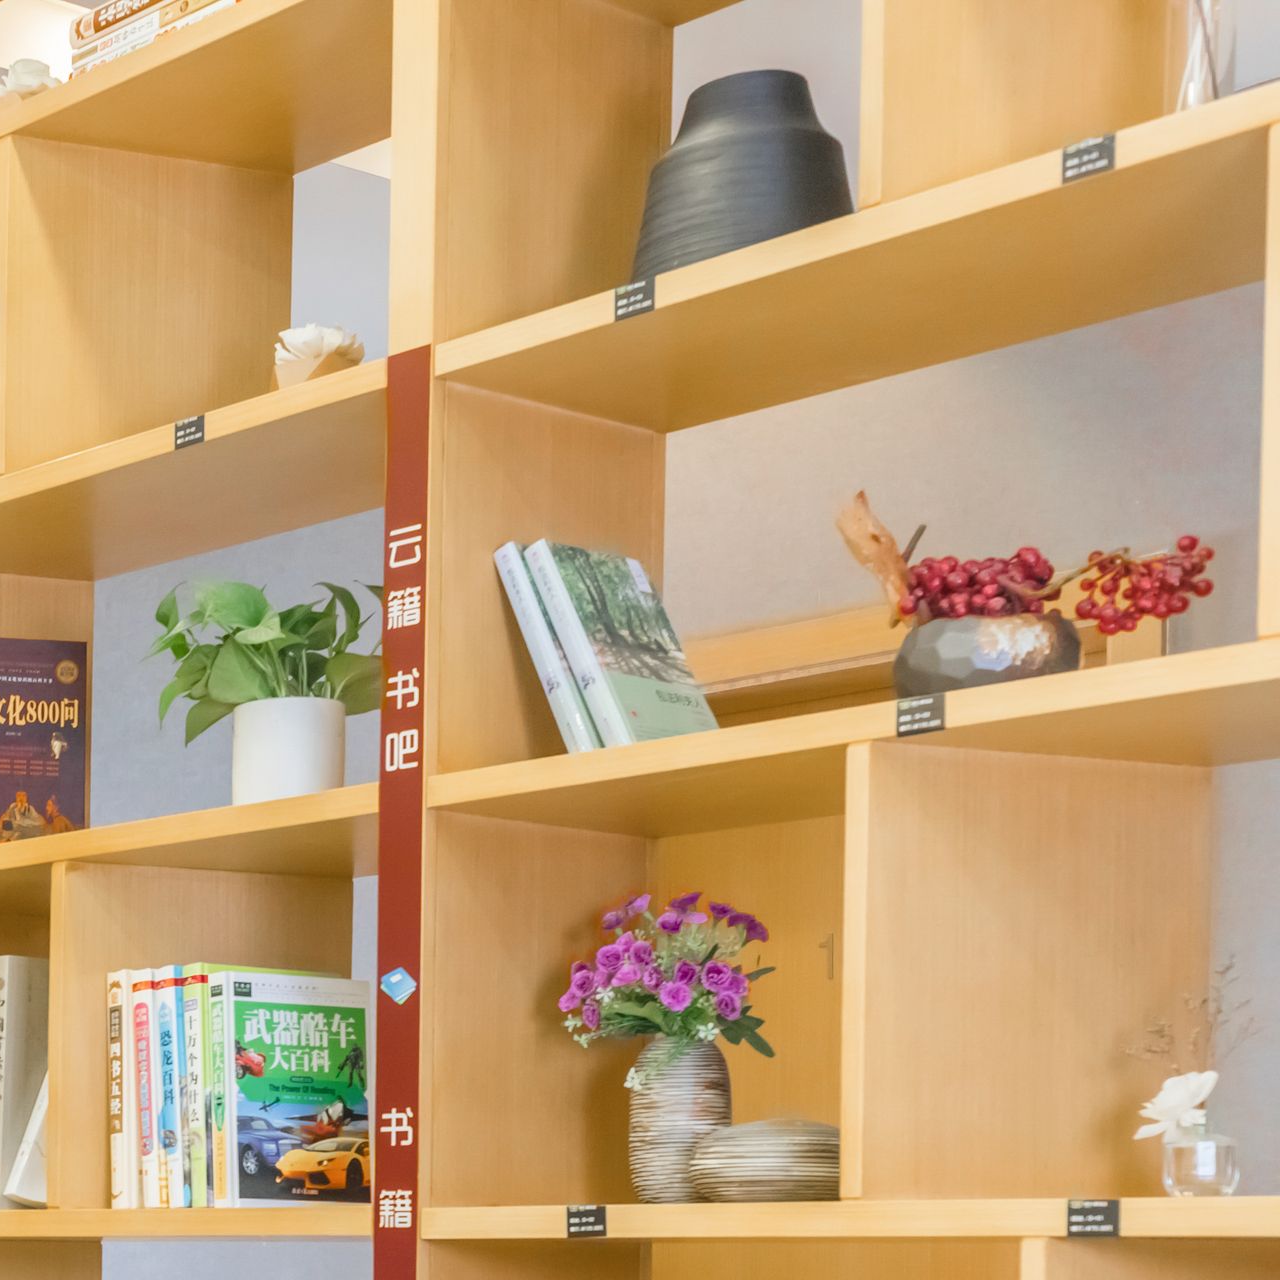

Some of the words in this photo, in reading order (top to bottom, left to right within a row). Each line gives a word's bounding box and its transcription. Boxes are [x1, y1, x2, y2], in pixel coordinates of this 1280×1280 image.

[385, 522, 423, 771] 云籍书吧
[244, 1008, 357, 1049] 武器酷车
[269, 1049, 330, 1074] 大百科
